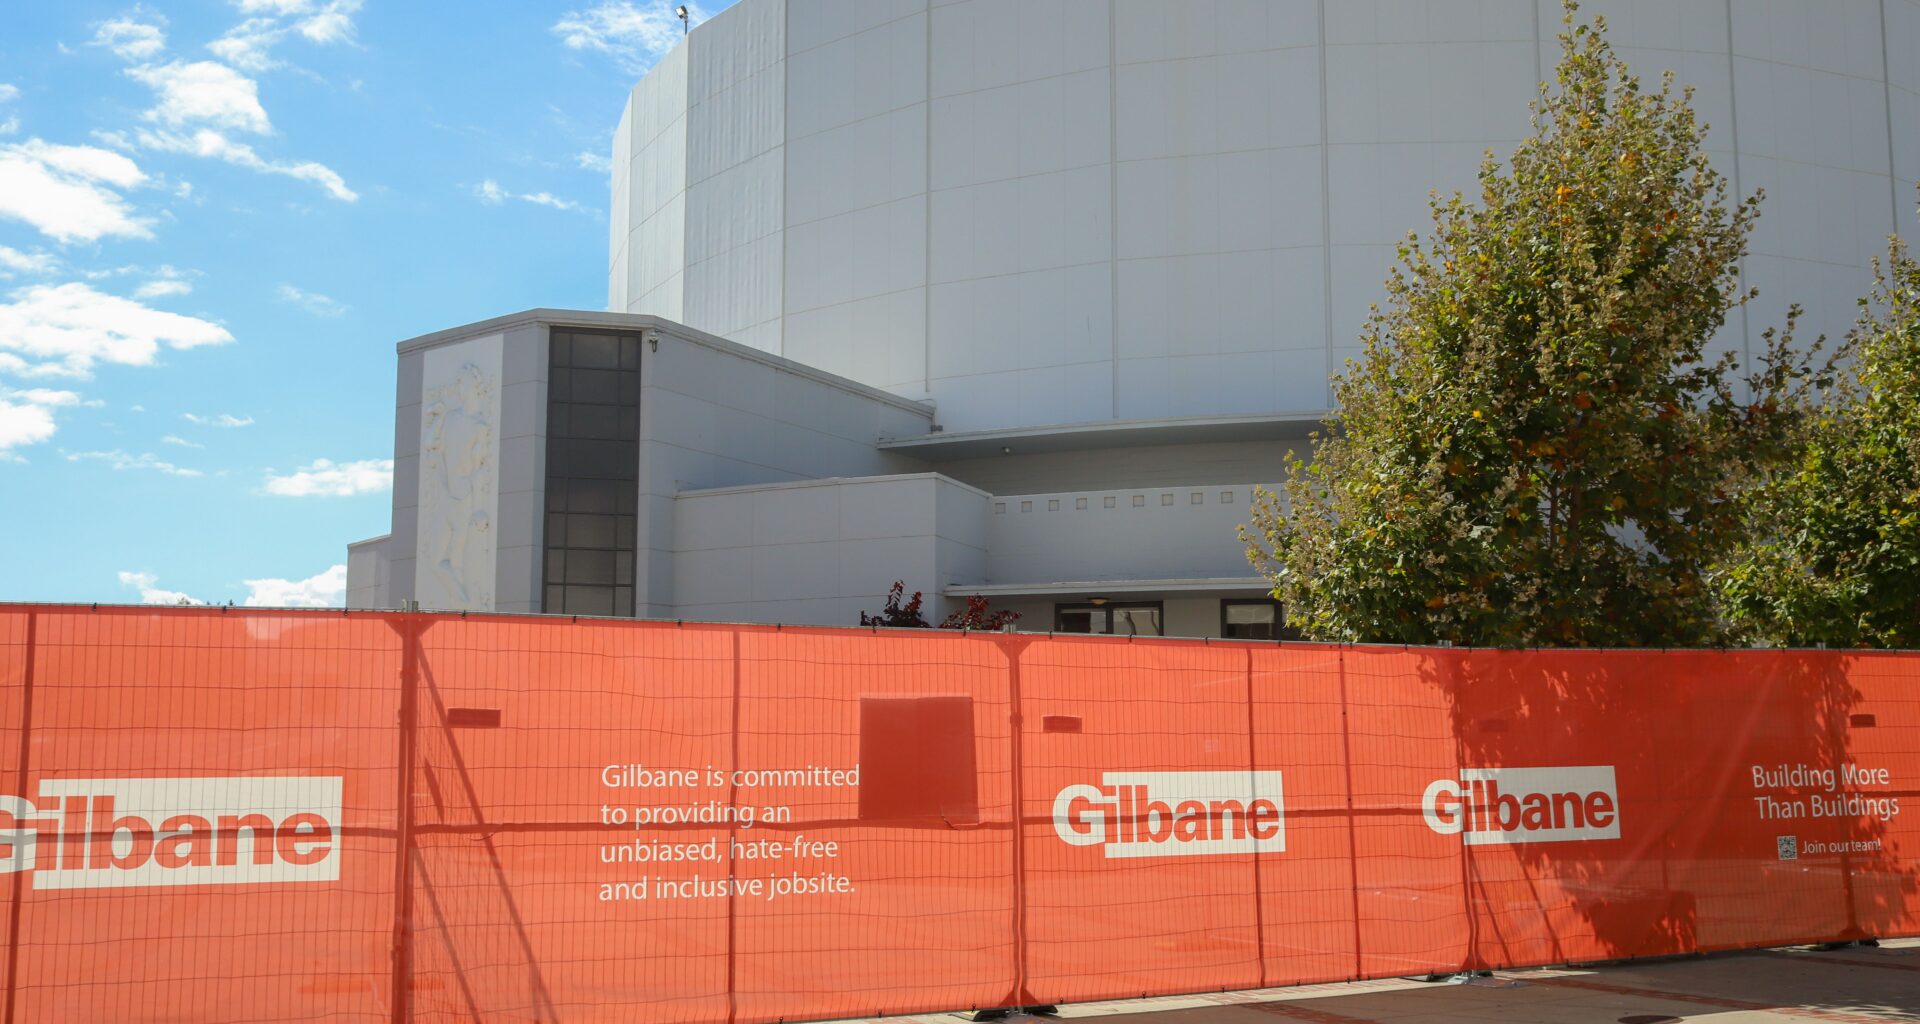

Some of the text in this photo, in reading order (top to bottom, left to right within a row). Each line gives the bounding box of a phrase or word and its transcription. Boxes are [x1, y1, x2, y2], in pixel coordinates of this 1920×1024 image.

[601, 763, 860, 787] Gilbane is committed
[1752, 763, 1889, 792] Building More
[601, 800, 790, 830] to providing an
[1053, 784, 1280, 846] Gilbane
[1422, 779, 1615, 835] Gilbane
[1754, 793, 1900, 821] Than Buildings
[600, 836, 838, 863] unbiased, hate-free
[1802, 838, 1881, 854] Join our team!
[599, 872, 855, 901] and inclusive jobsite.
